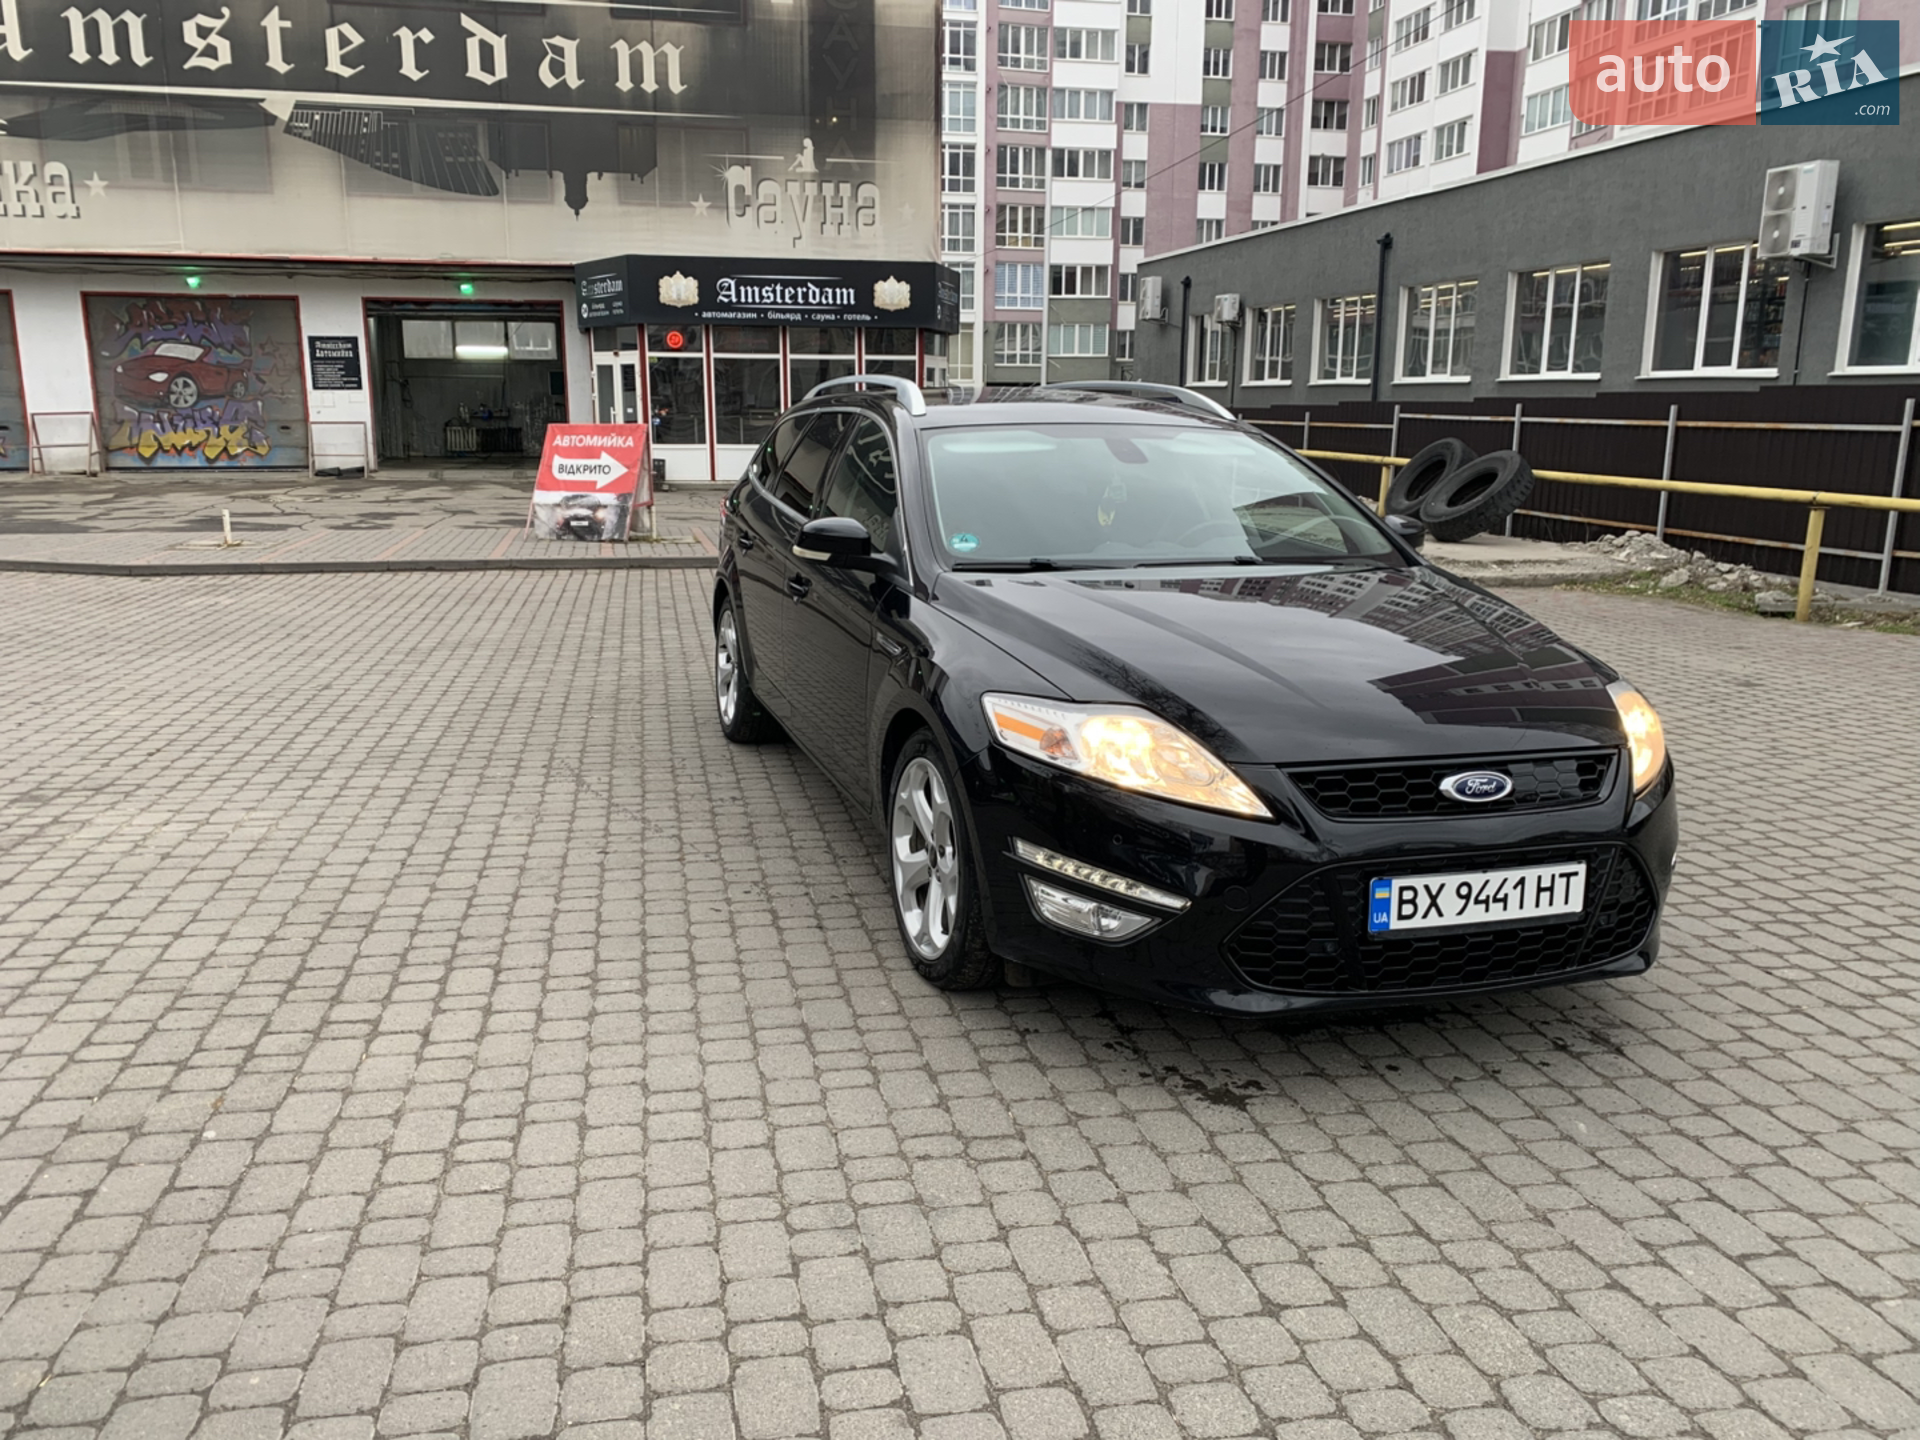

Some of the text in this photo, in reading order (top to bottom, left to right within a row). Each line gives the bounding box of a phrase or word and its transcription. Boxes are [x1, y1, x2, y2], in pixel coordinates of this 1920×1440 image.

[822, 0, 861, 171] АУНА
[0, 160, 81, 219] ка
[716, 277, 856, 305] Amsterdam
[701, 310, 872, 322] автомагазин більярд сауна готель
[552, 433, 634, 448] АВТОМИЙКА
[557, 463, 612, 476] ВІДКРИТО
[1464, 778, 1497, 795] Ford
[1373, 912, 1389, 924] UA
